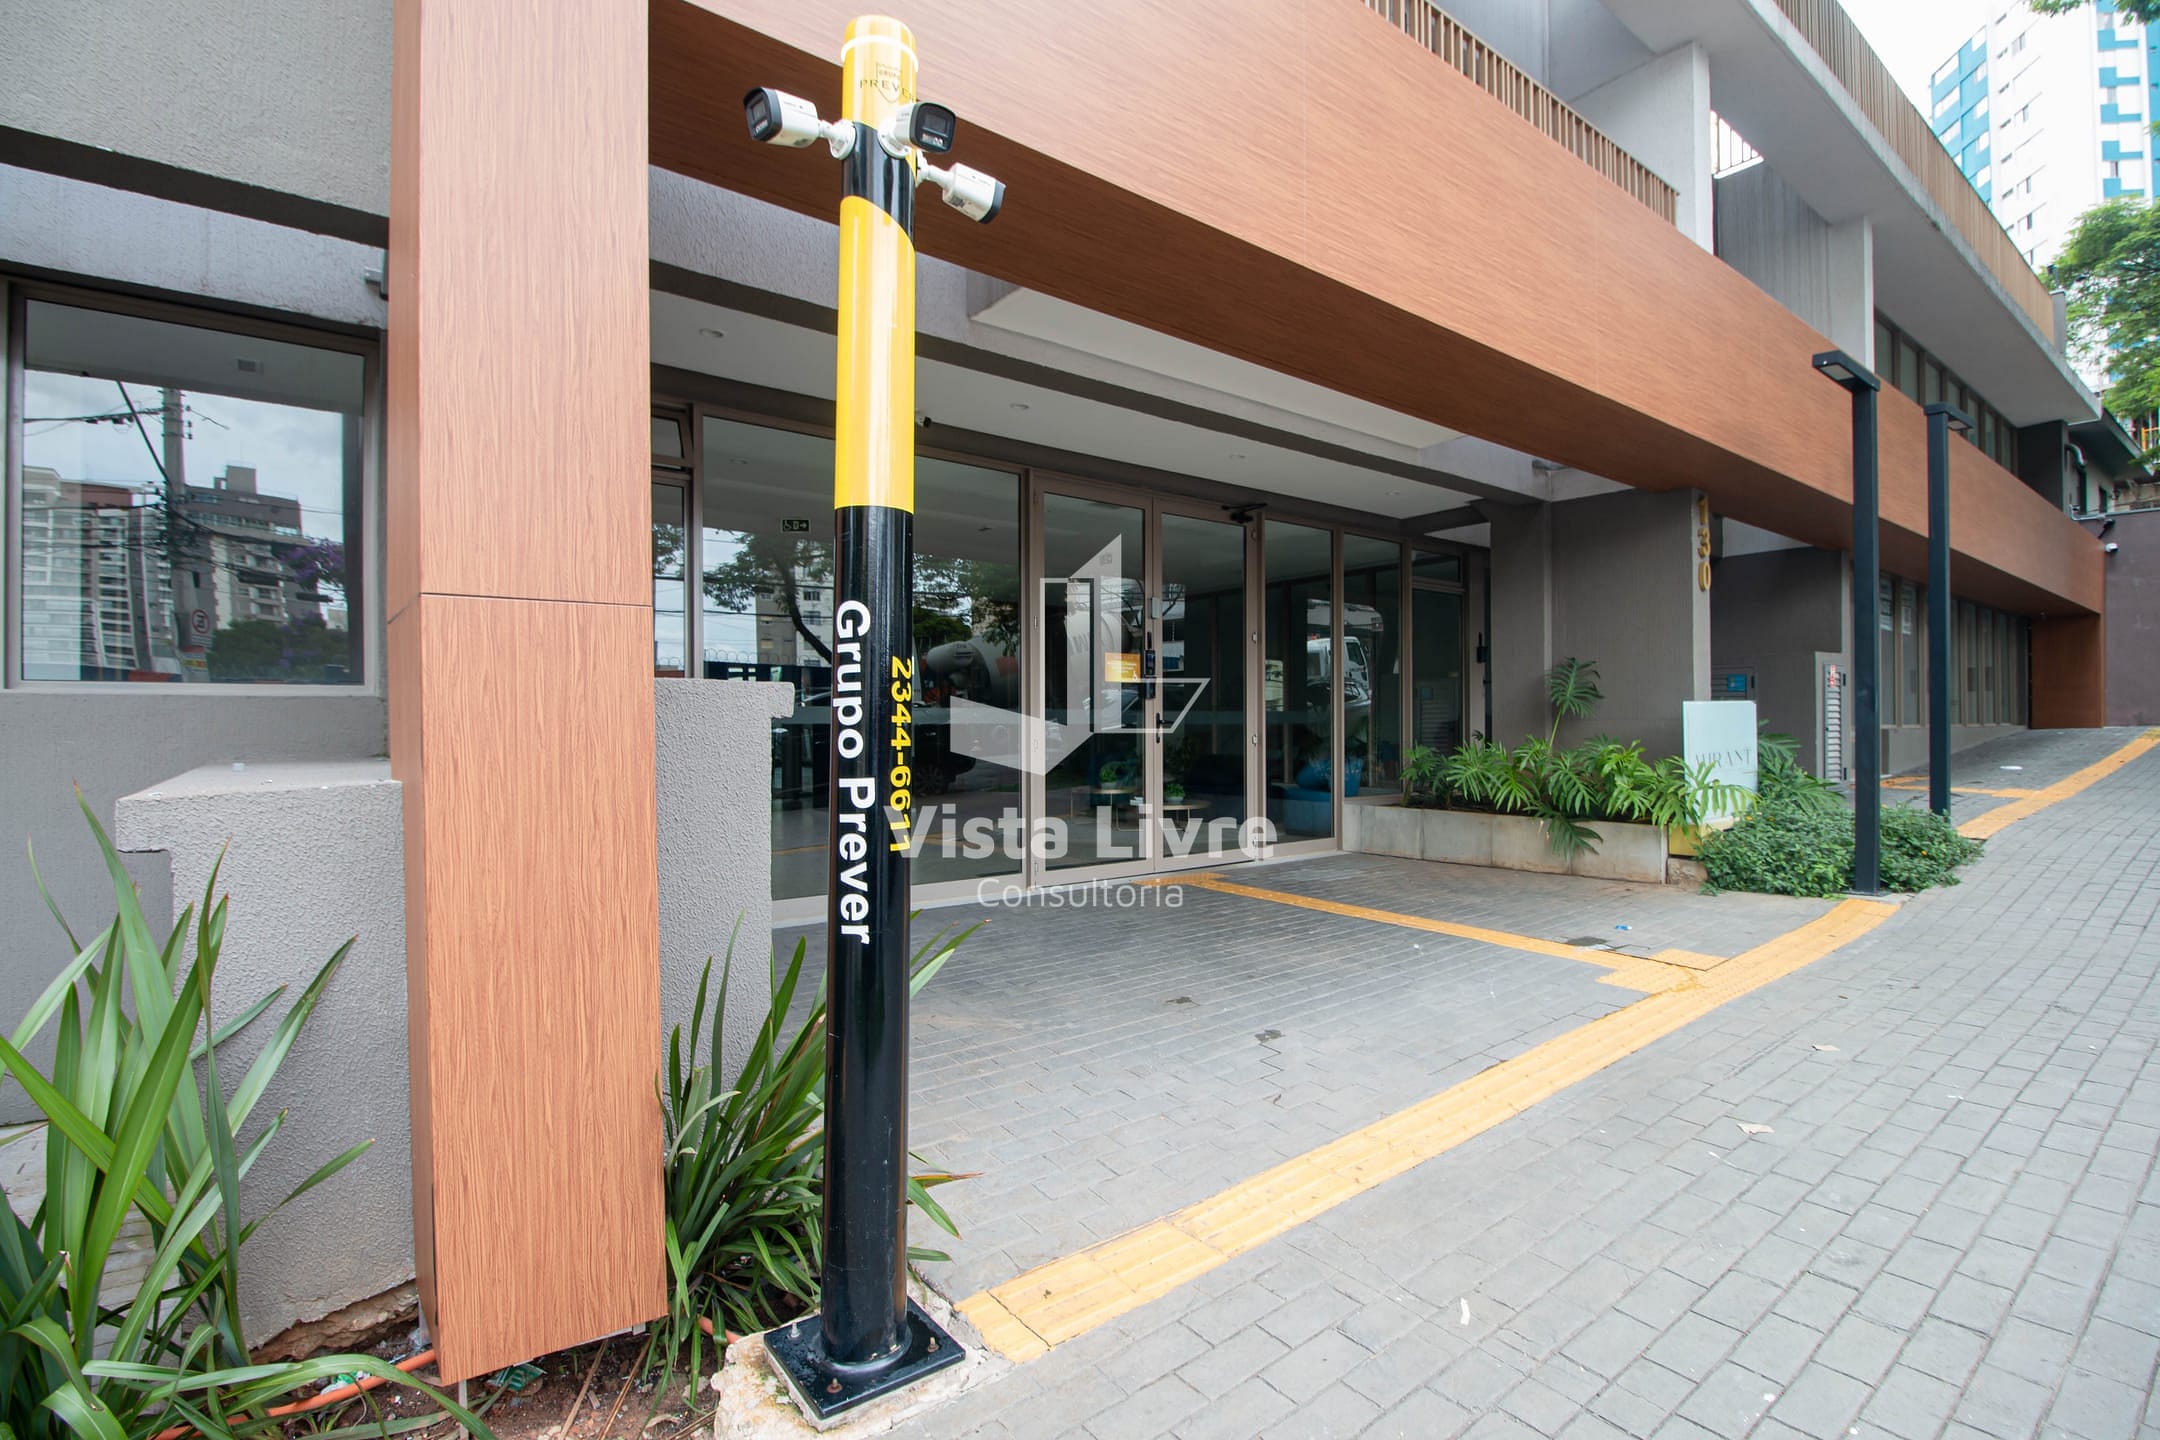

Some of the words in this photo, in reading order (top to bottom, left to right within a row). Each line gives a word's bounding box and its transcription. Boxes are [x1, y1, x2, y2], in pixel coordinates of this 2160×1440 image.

[833, 600, 871, 759] Grupo
[889, 656, 912, 853] 2344-6611
[838, 777, 875, 944] Prever
